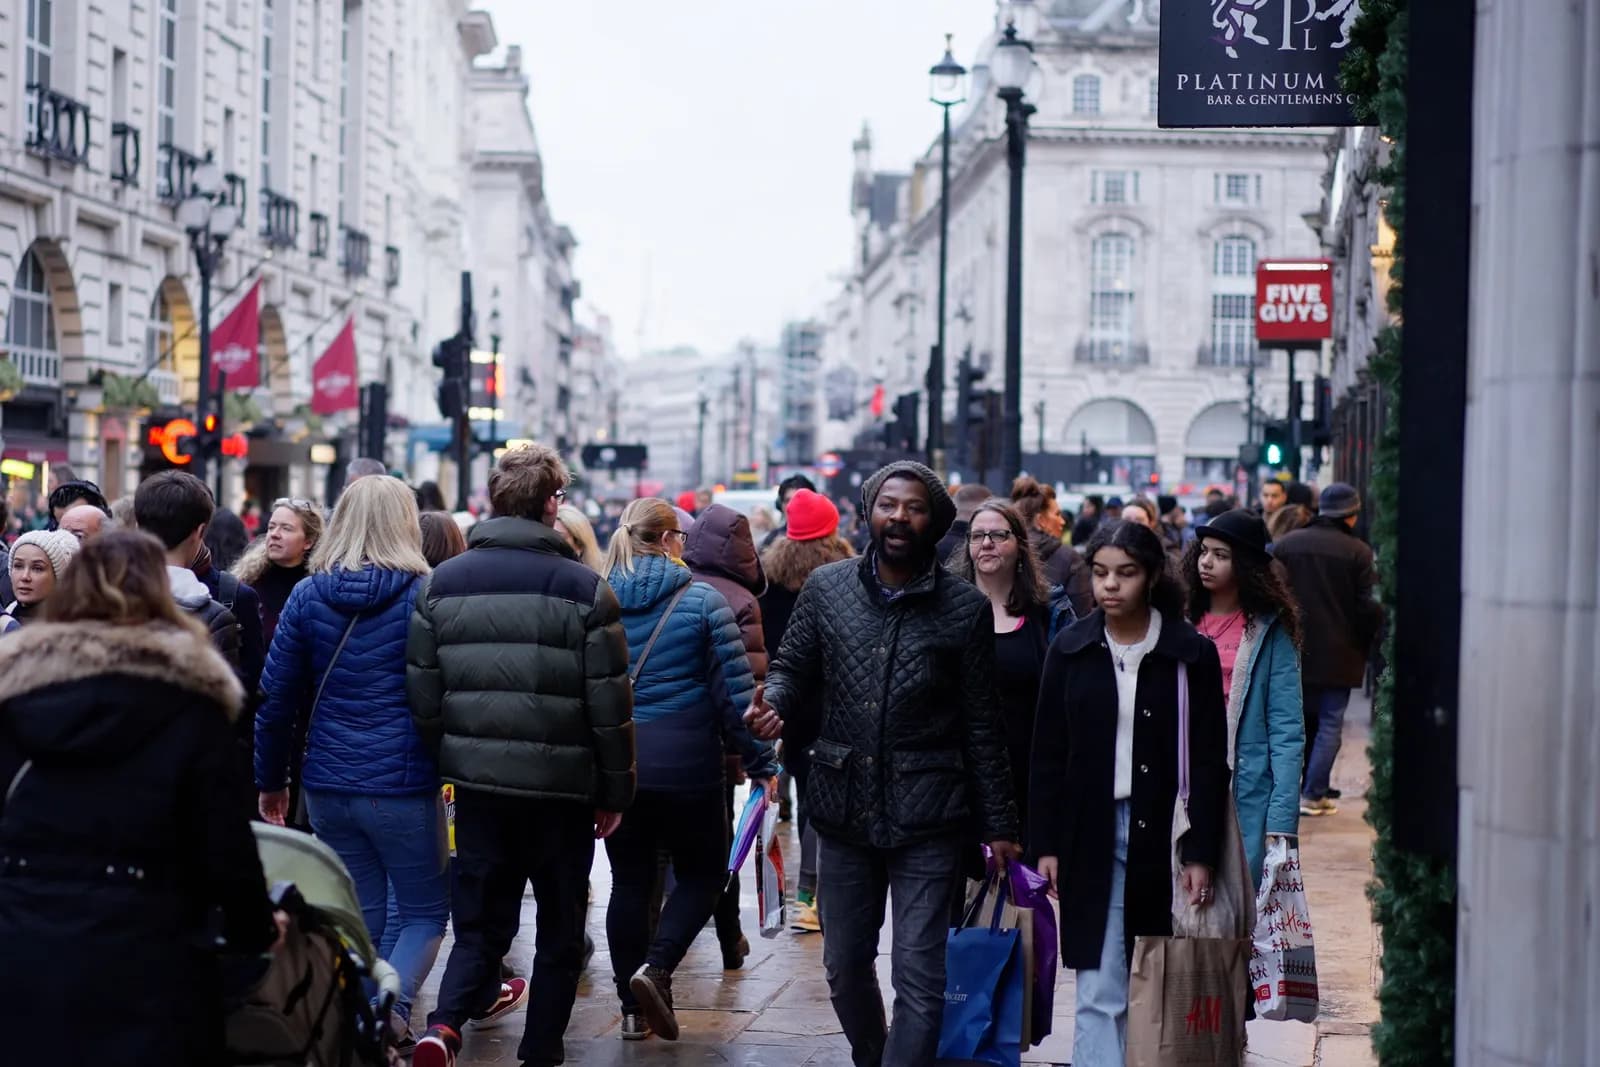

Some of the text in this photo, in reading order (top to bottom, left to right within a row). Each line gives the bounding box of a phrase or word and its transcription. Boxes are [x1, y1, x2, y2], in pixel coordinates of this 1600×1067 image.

[1176, 73, 1324, 90] PLATINUM
[1207, 95, 1232, 105] BAR
[1236, 95, 1245, 105] &
[1249, 93, 1342, 105] GENTLEMEN'S
[1266, 284, 1322, 303] FIVE
[1259, 303, 1328, 323] GUYS
[1185, 995, 1222, 1036] H&M
